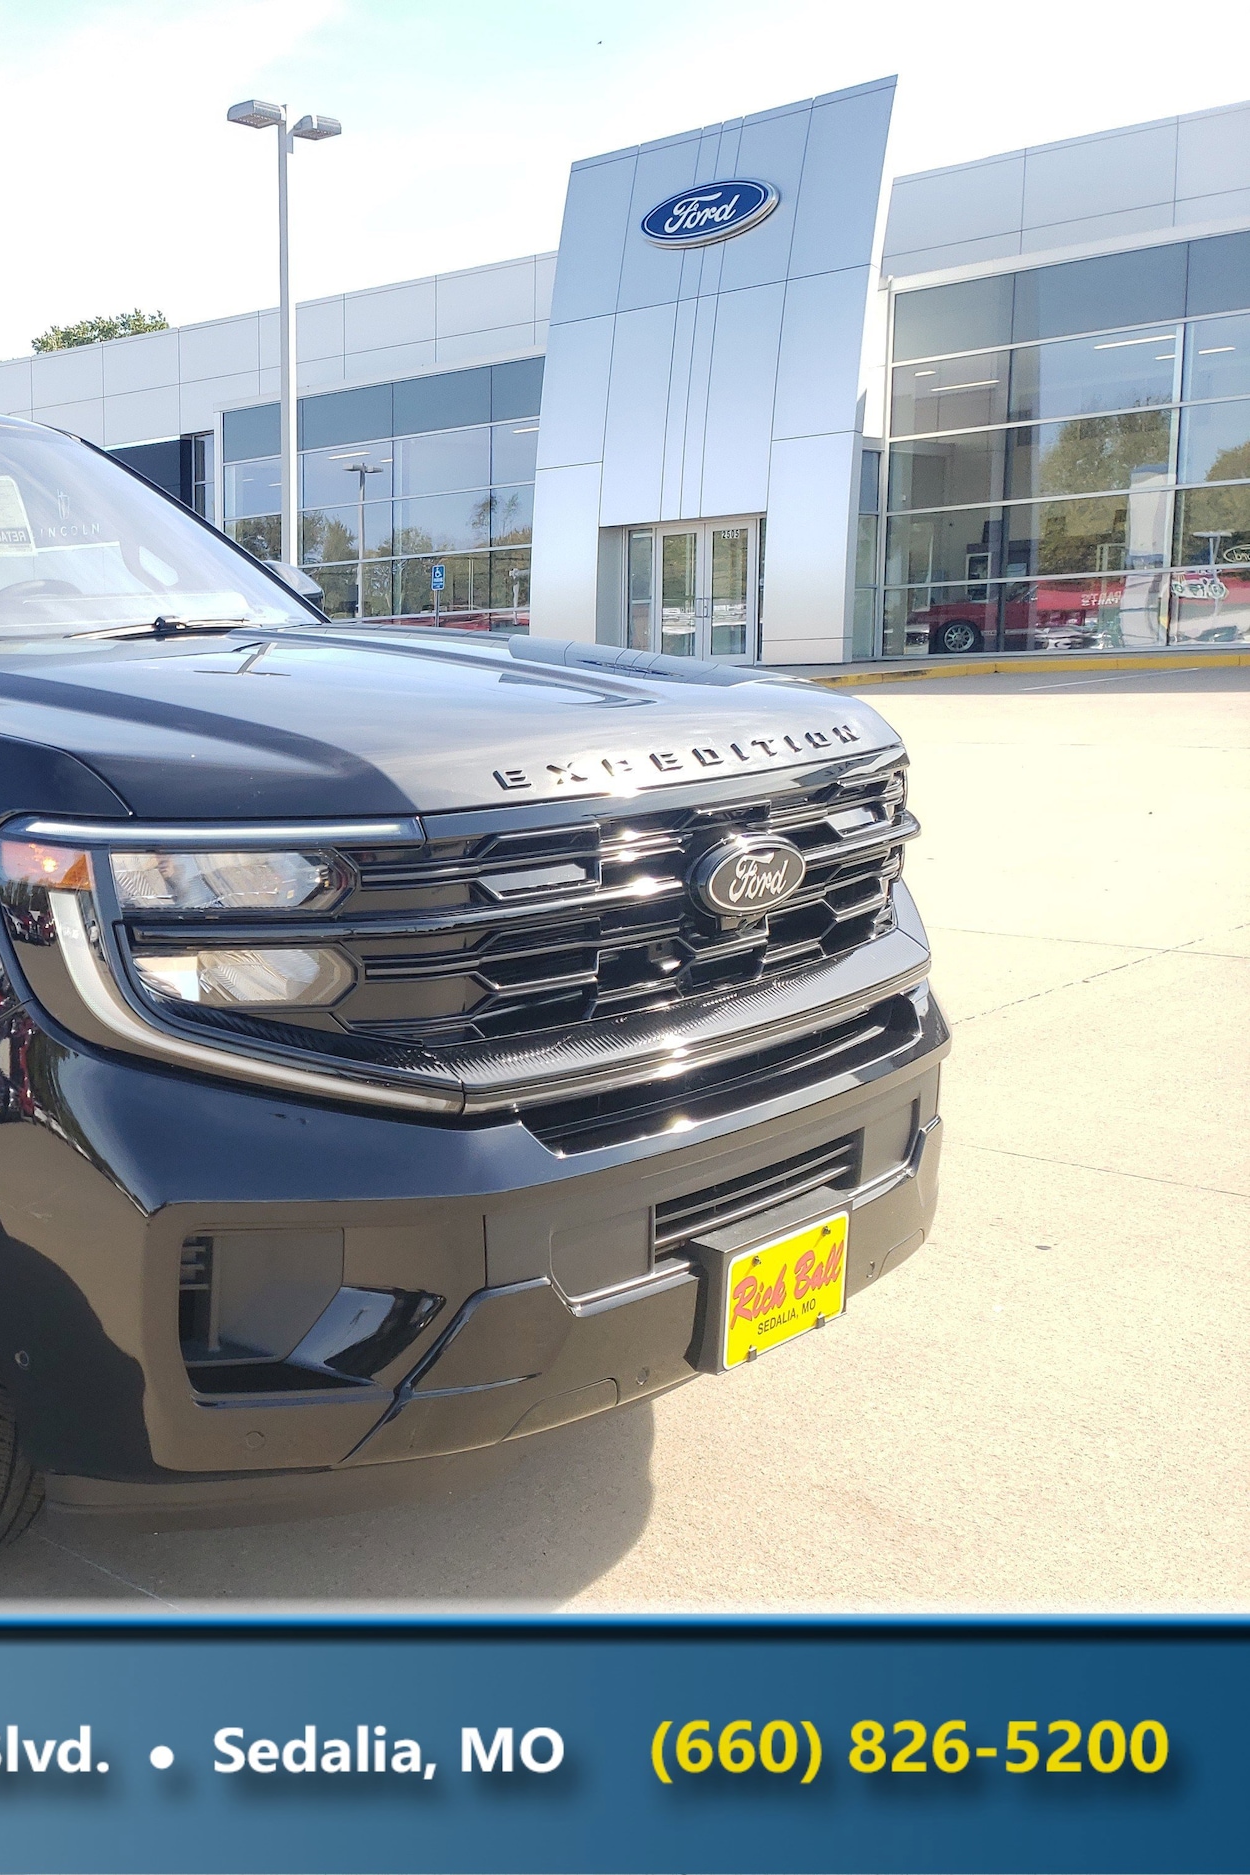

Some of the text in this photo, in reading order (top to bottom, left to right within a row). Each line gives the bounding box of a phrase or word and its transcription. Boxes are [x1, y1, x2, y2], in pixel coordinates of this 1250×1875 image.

[664, 192, 741, 233] Ford
[31, 523, 100, 539] INCOLN
[721, 529, 740, 539] 2505
[492, 724, 861, 790] EXPEDITION
[728, 851, 789, 903] Ford
[730, 1239, 845, 1330] Rick Ball
[757, 1298, 817, 1336] SEDALIA, MO
